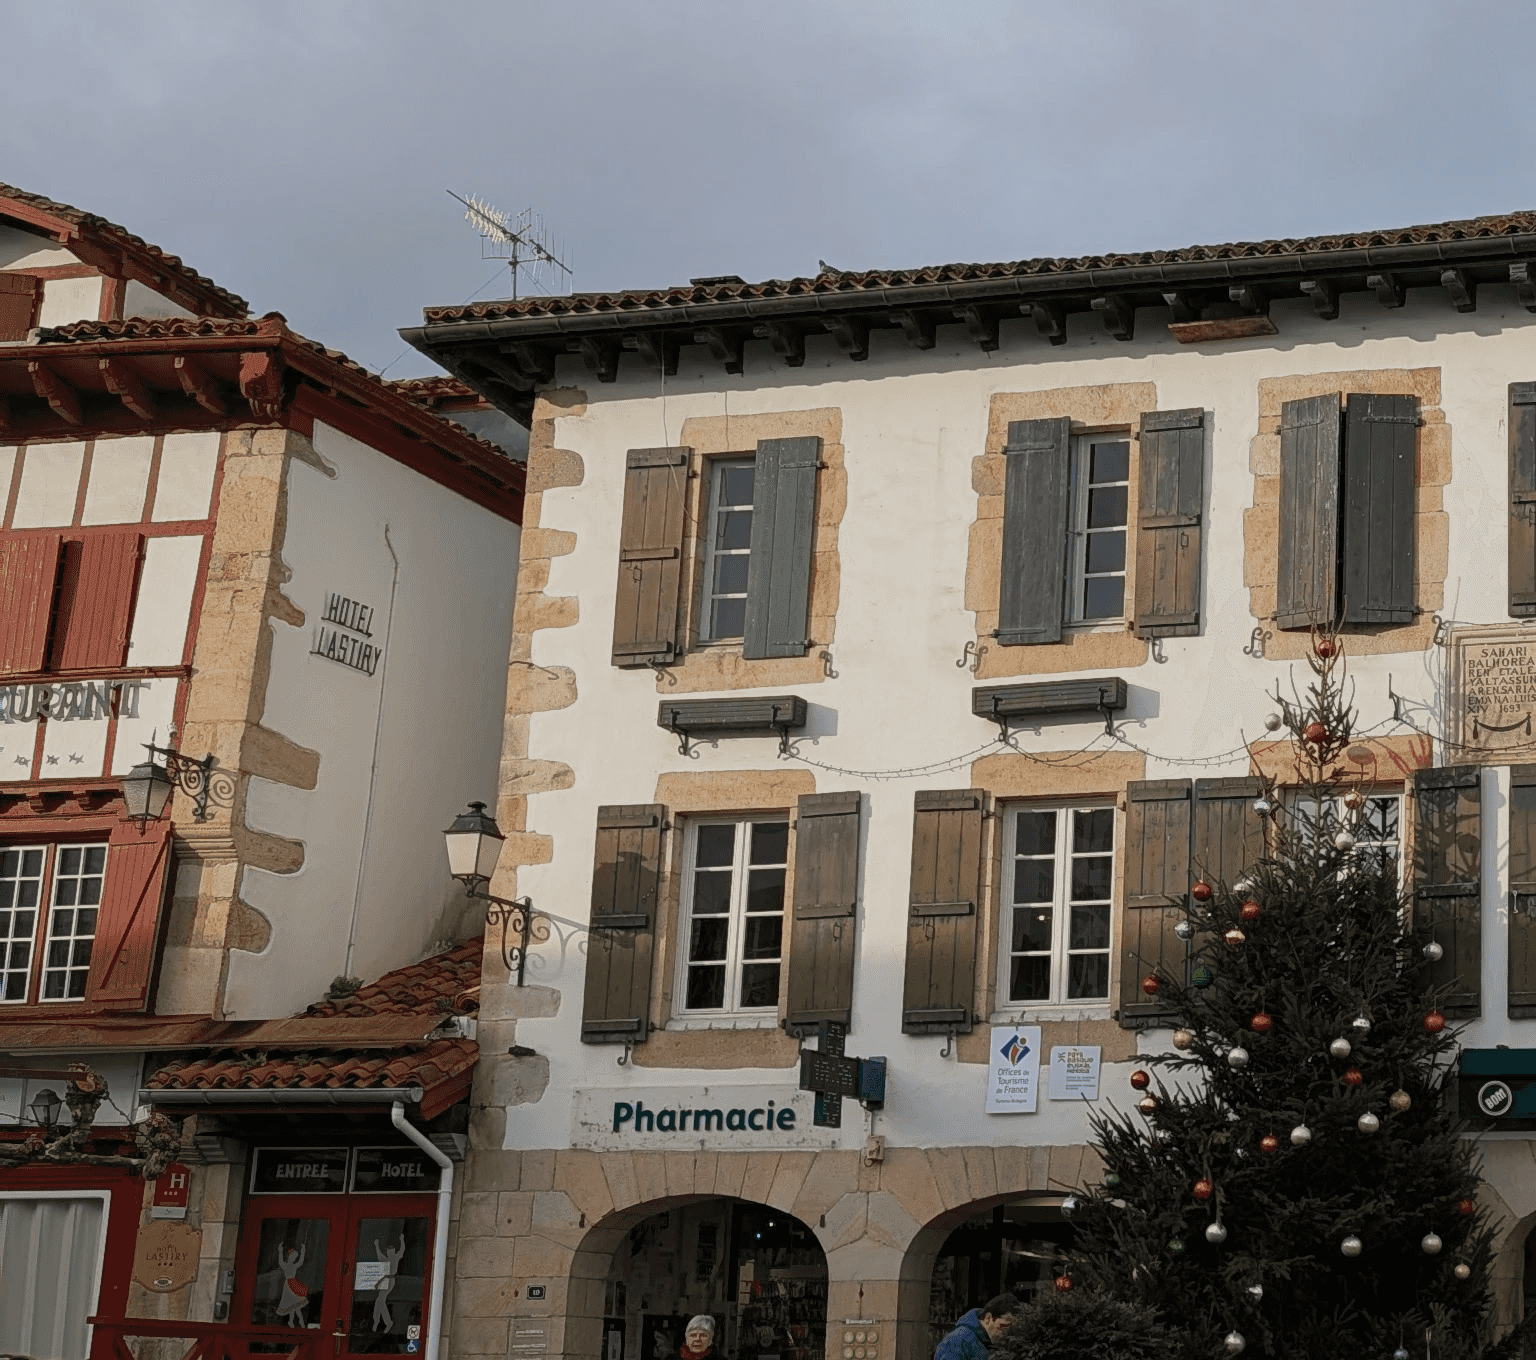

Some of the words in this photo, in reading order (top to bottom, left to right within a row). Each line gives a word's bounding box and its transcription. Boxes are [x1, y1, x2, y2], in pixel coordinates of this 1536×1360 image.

[325, 592, 375, 638] HOTEL
[314, 627, 383, 677] LASTIRY
[1468, 669, 1490, 677] REN
[1470, 676, 1536, 686] YALTASSUN
[1514, 694, 1536, 703] LUIS
[1467, 705, 1488, 714] XIV
[1500, 704, 1520, 713] 1693
[1004, 1085, 1028, 1094] France
[613, 1100, 796, 1133] Pharmacie
[276, 1164, 329, 1178] ENTREE
[381, 1163, 425, 1177] HOTEL
[170, 1173, 186, 1189] H
[146, 1252, 188, 1261] LASTIRY
